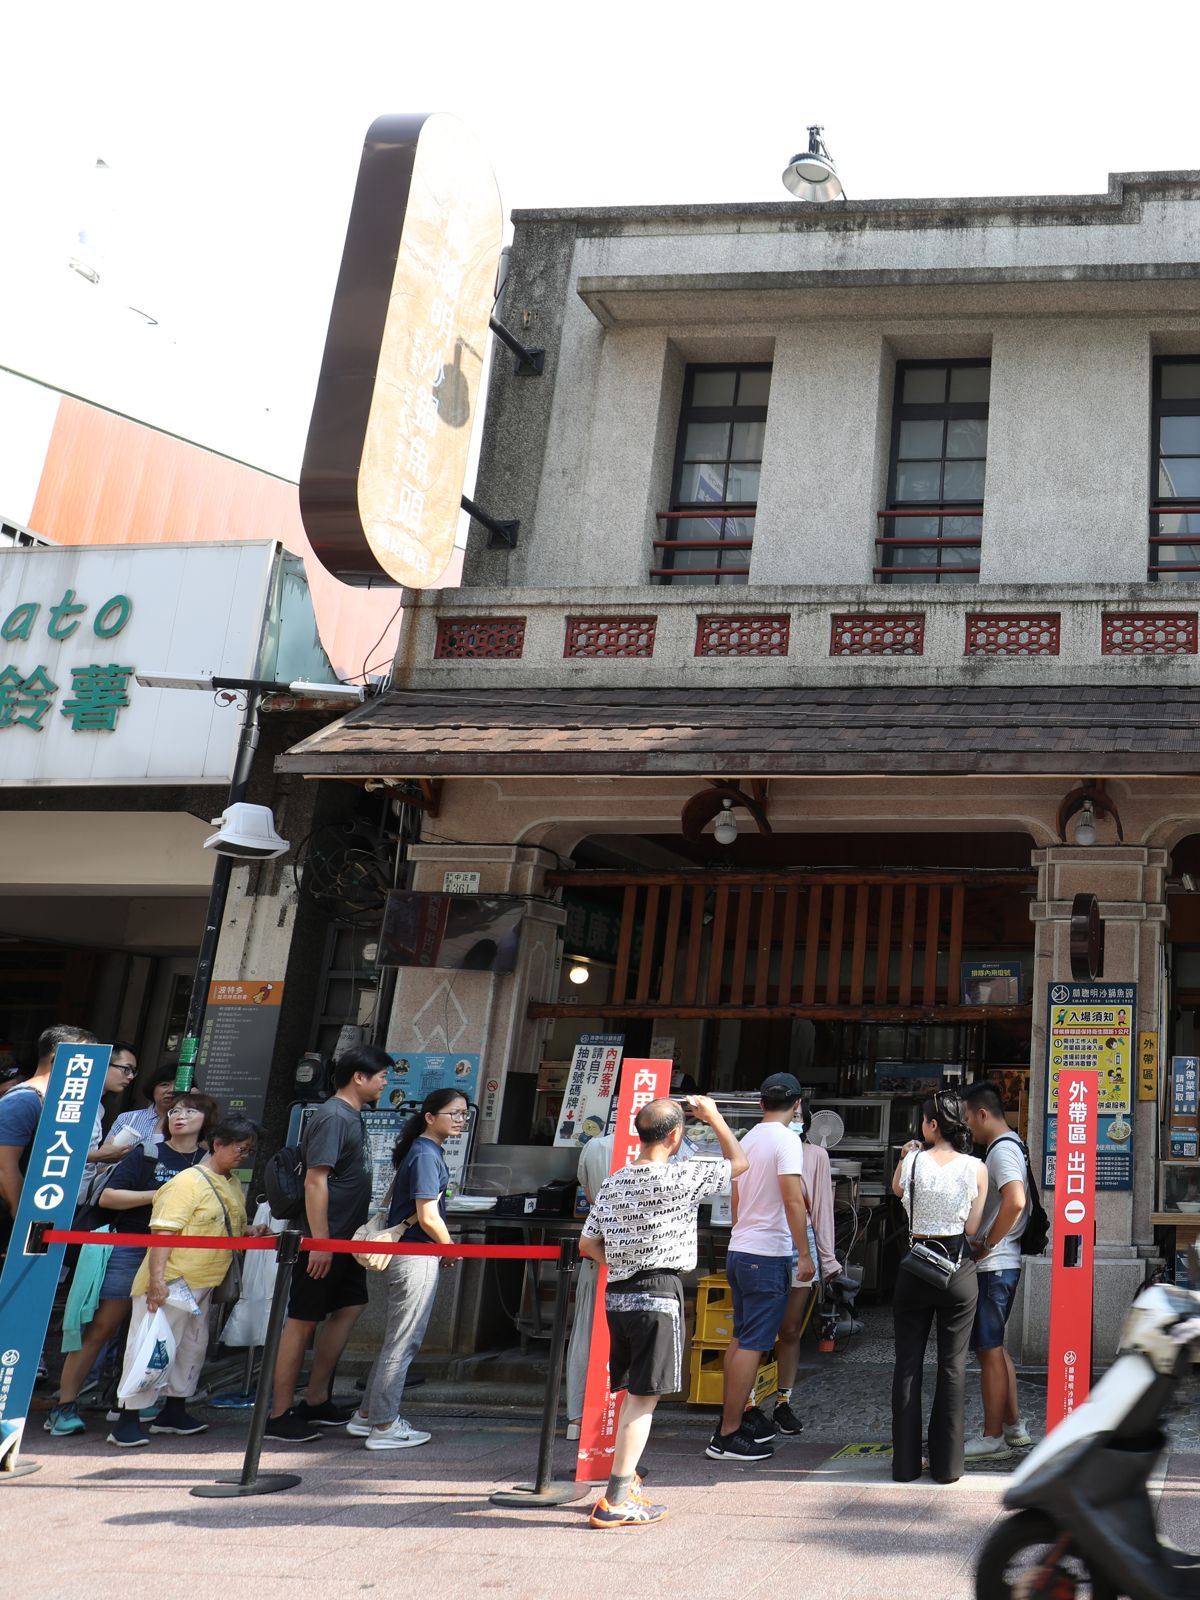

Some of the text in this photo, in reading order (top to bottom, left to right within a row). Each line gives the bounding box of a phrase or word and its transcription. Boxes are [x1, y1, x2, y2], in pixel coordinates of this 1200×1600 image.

[1069, 1011, 1114, 1022] 入場須知
[566, 1047, 590, 1109] 抽取號碼牌
[587, 1047, 603, 1084] 請自行
[597, 1048, 618, 1098] 內用客滿
[1143, 1039, 1154, 1080] 外帶區
[1175, 1074, 1184, 1101] 請自取
[1185, 1059, 1195, 1101] 外帶菜單
[42, 1054, 94, 1178] 內用區 入口
[1067, 1081, 1088, 1194] 外帶區 出口
[637, 1199, 663, 1207] PUMA
[653, 1184, 680, 1193] PUMA
[622, 1213, 644, 1221] PUMA
[653, 1206, 681, 1216] PUMA
[636, 1222, 662, 1231] PUMA
